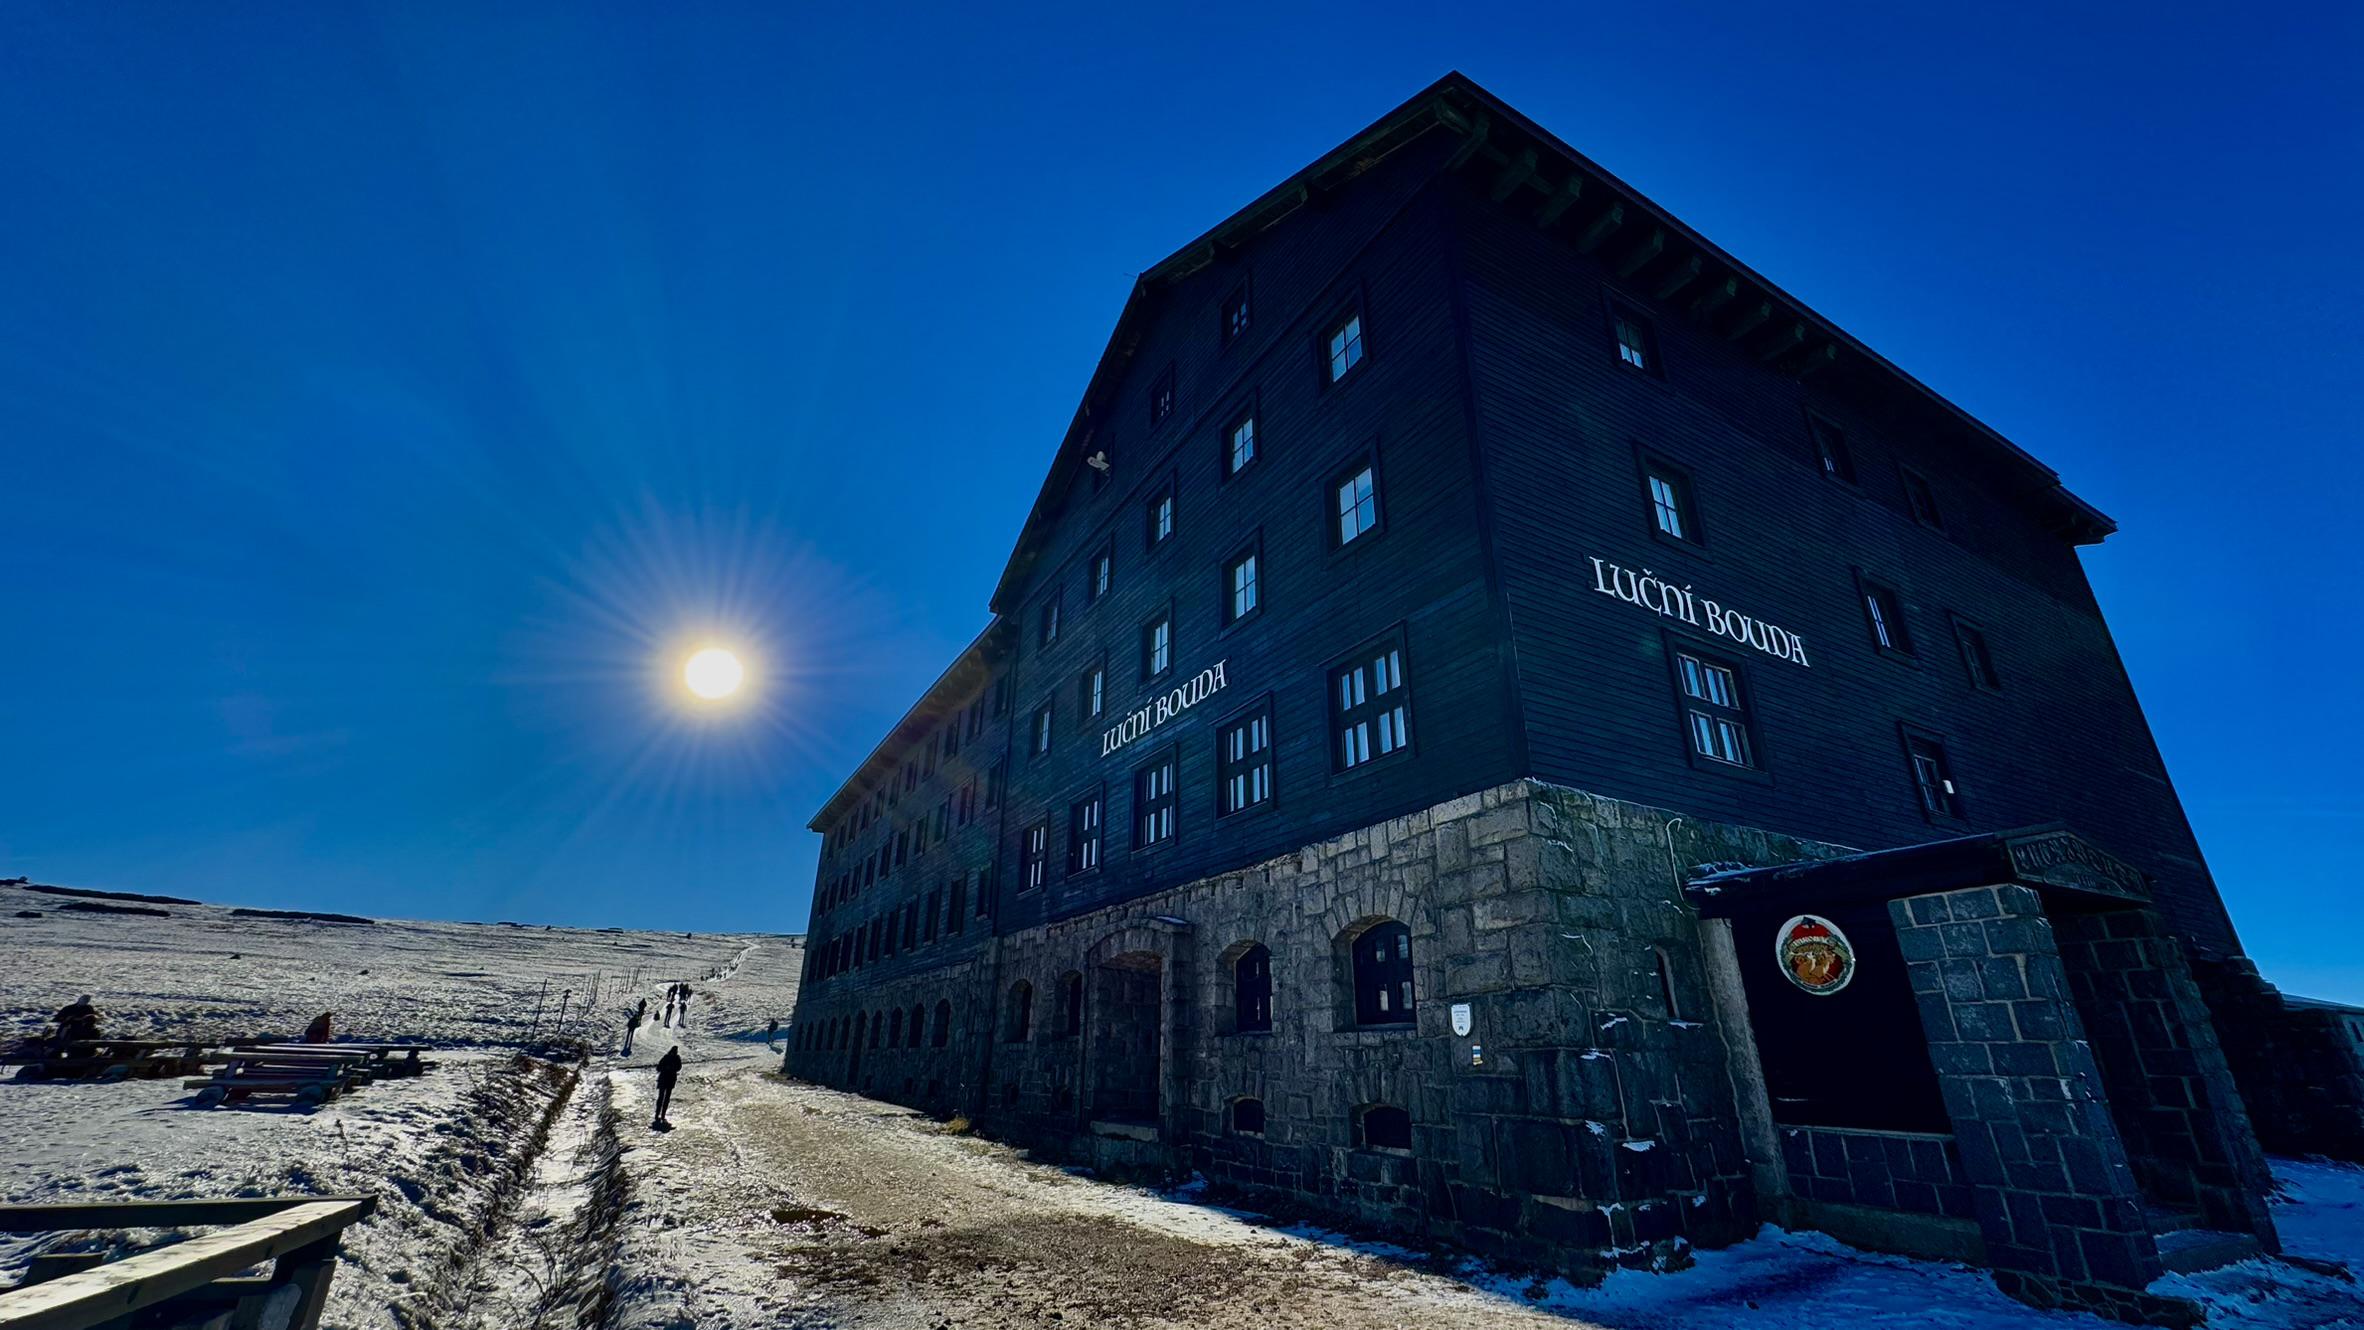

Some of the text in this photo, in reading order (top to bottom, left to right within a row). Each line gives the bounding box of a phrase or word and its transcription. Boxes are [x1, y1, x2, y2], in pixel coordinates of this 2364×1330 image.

[1589, 556, 1811, 668] LUČNÍ BOUDA
[1153, 658, 1228, 728] BOUDA
